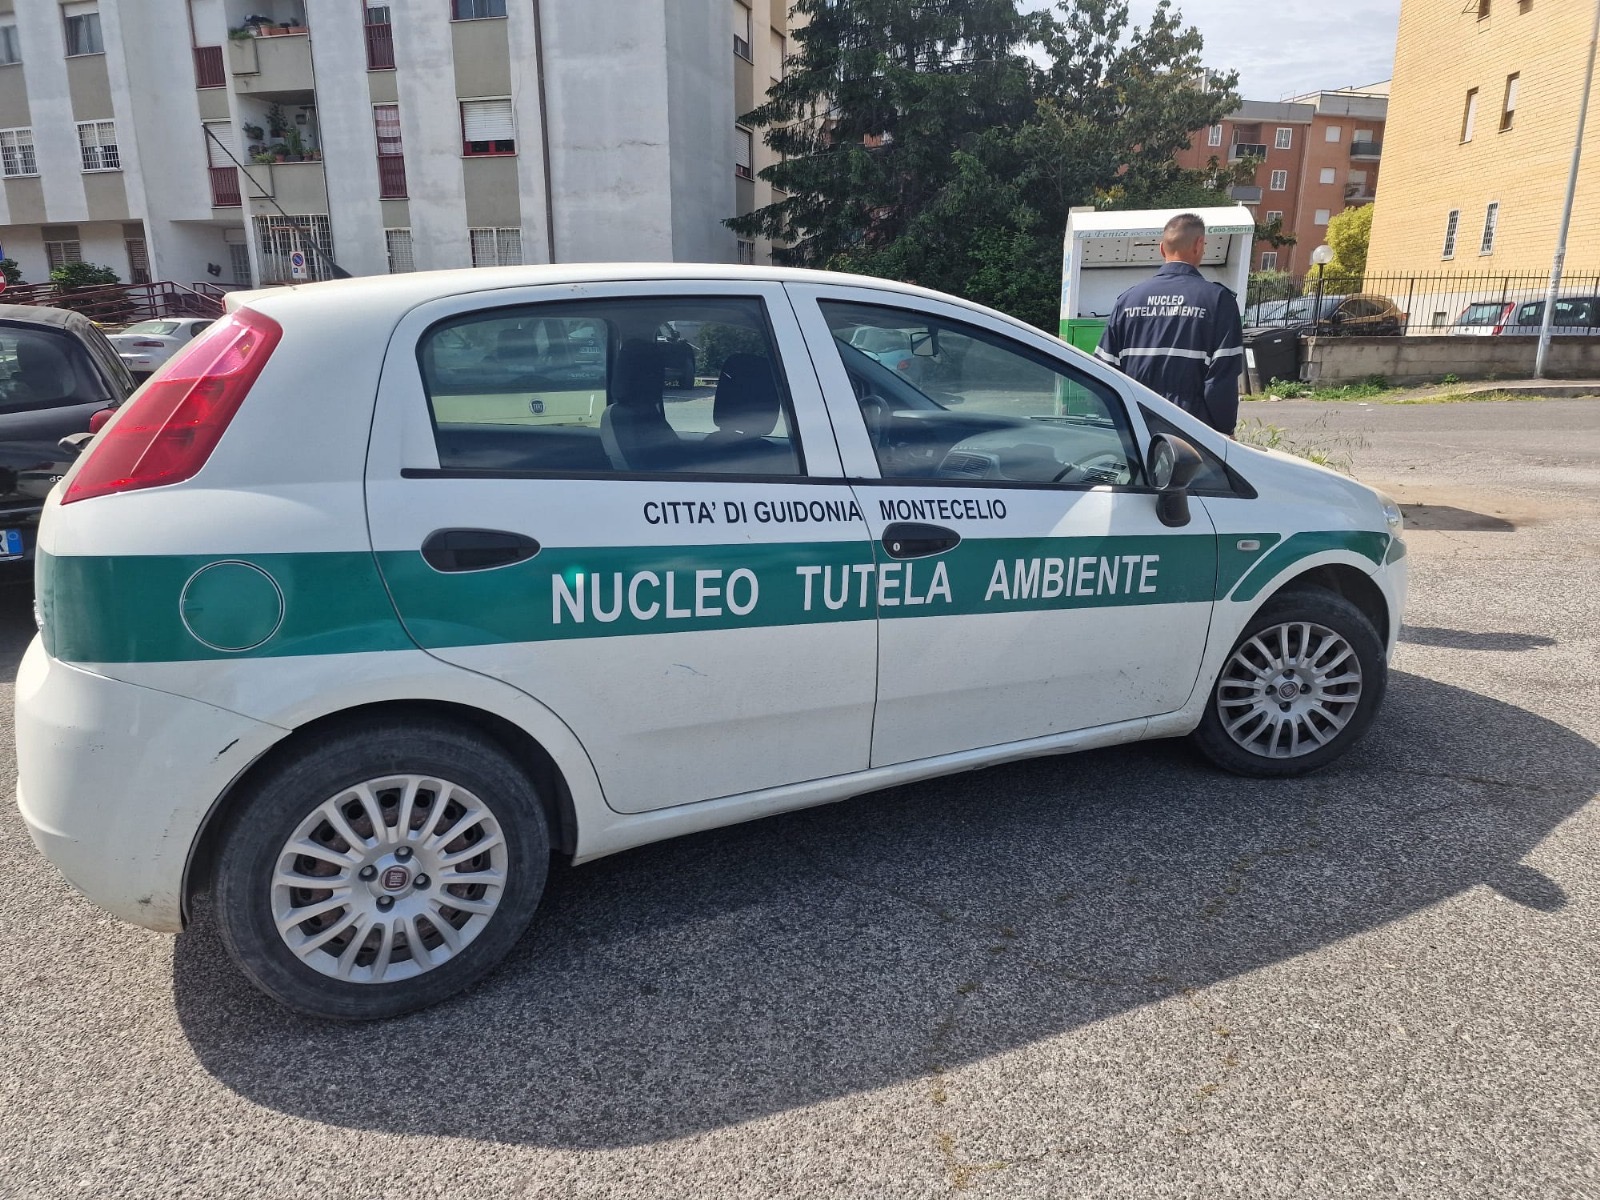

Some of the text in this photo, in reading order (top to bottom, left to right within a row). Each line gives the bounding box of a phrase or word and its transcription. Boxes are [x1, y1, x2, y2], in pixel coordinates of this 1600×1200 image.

[1147, 295, 1184, 306] NUCLEO
[1124, 306, 1206, 318] TUTELA AMBIENTE
[643, 500, 1007, 524] CITTA' DI GUIDONIA MONTECELIO
[552, 554, 1160, 624] NUCLEO TUTELA AMBIENTE
